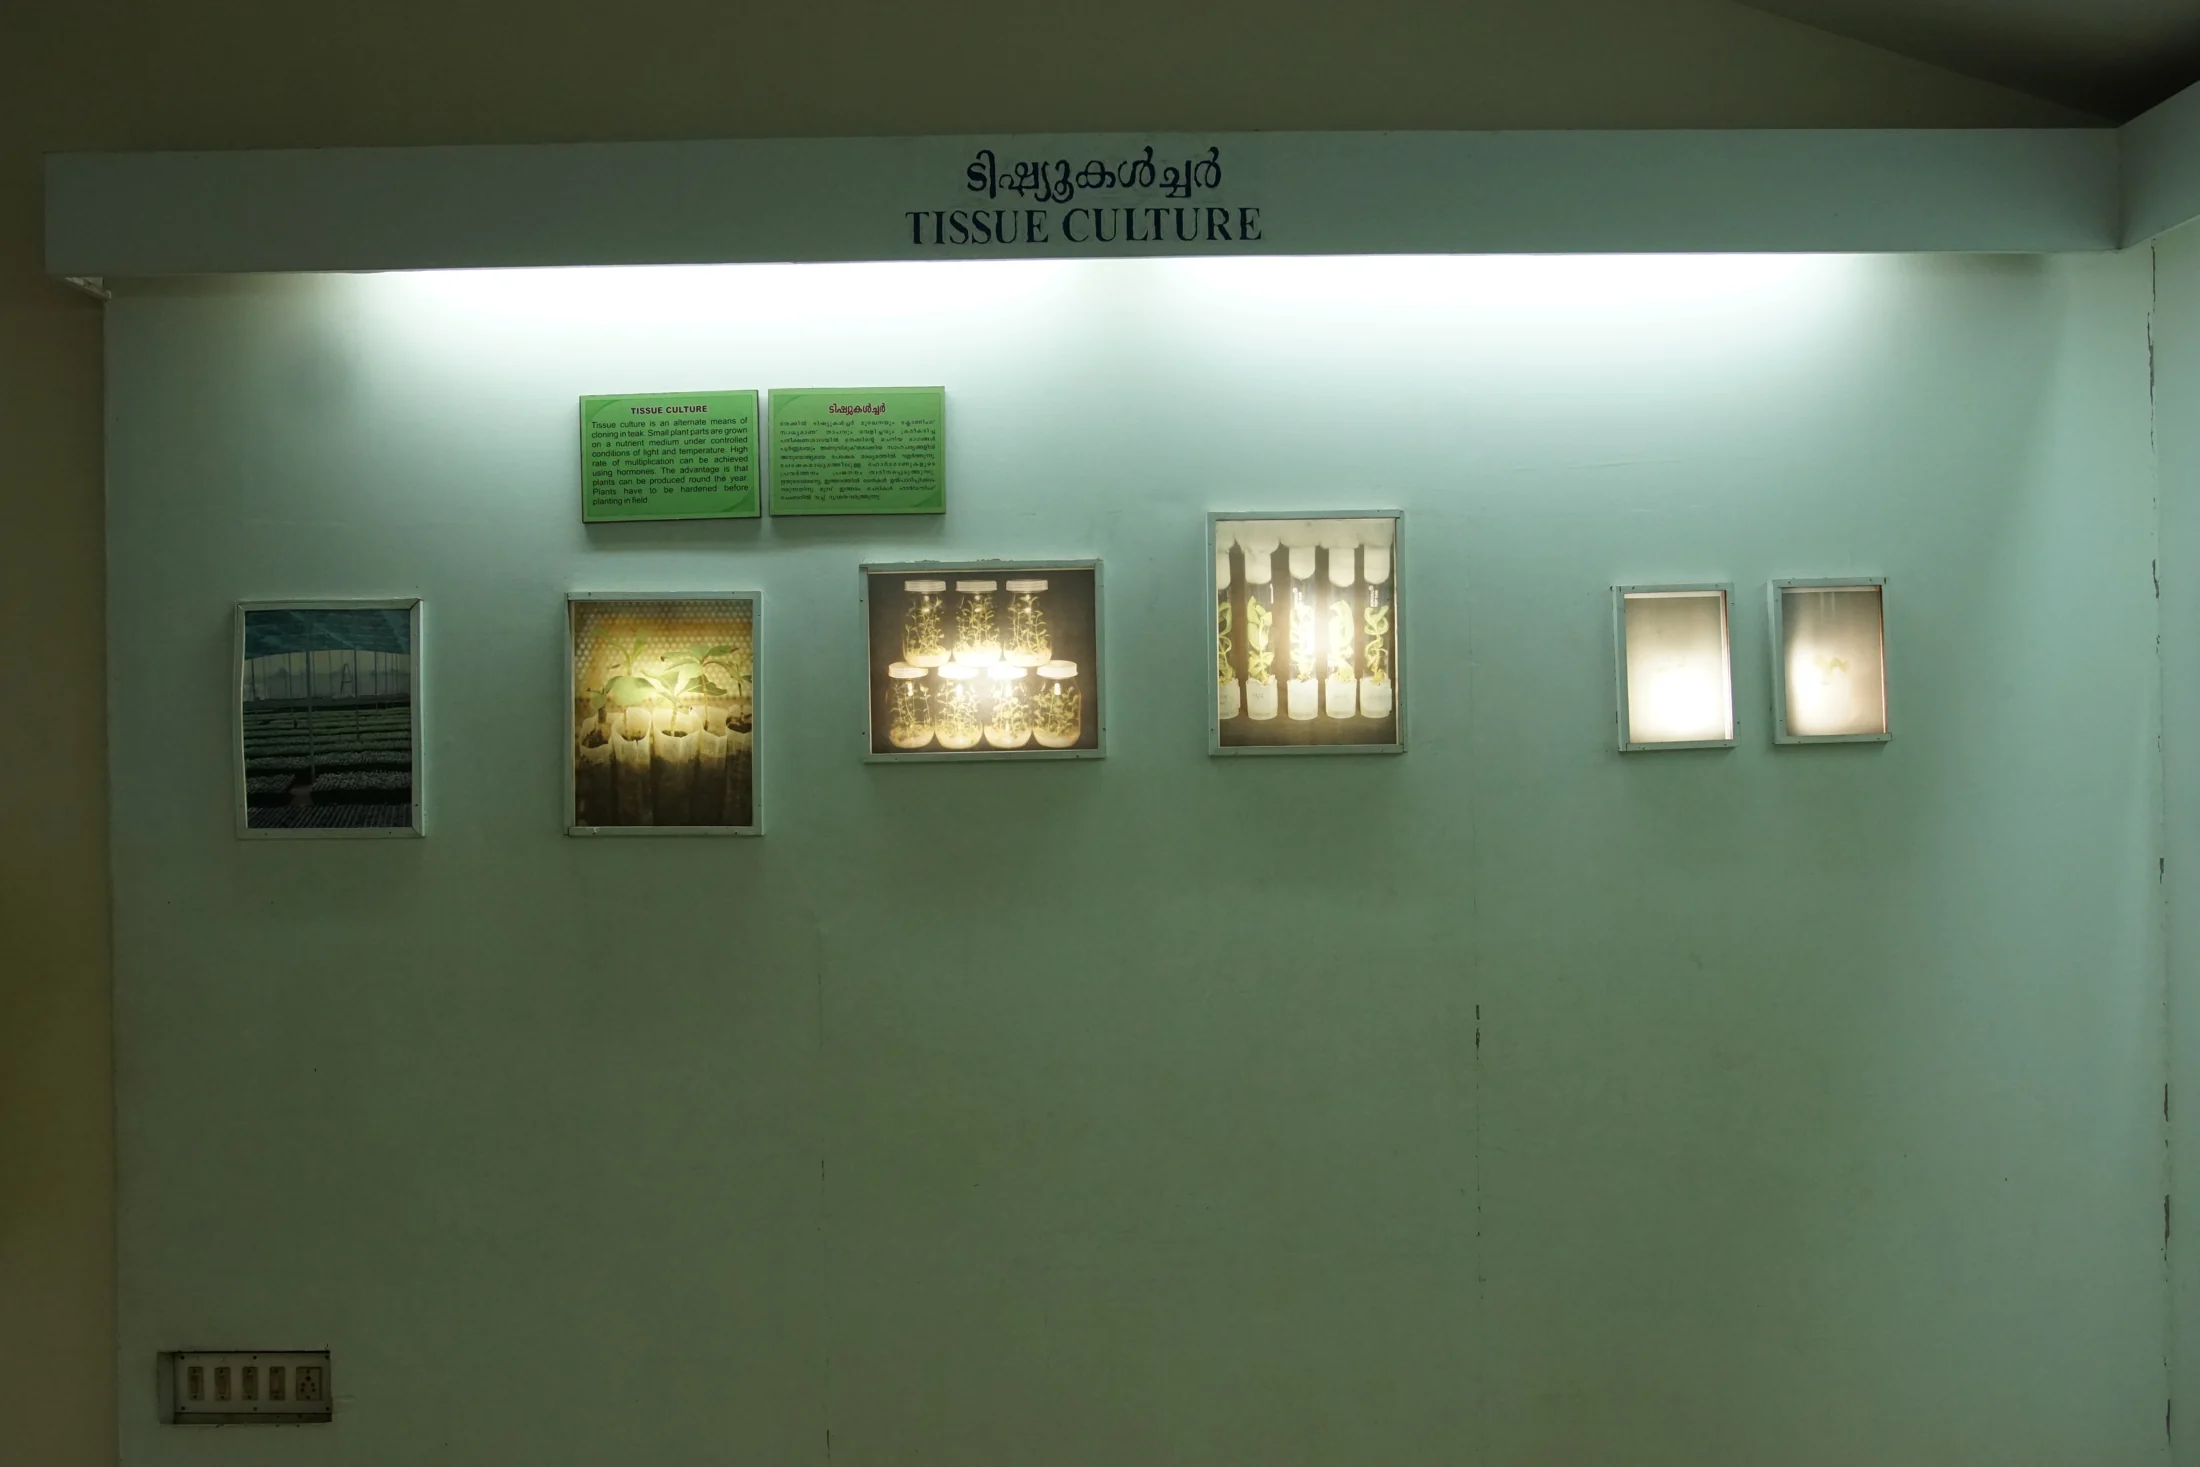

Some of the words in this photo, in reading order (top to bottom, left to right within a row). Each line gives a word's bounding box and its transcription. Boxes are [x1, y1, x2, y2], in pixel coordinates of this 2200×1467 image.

[905, 210, 1049, 245] TISSUE
[1062, 207, 1262, 242] CULTURE
[631, 407, 663, 415] TISSUE
[666, 406, 708, 414] CULTURE
[620, 420, 645, 428] culture
[592, 431, 618, 440] cloning
[670, 429, 689, 437] plant
[592, 450, 630, 458] conditions
[643, 448, 658, 457] light
[731, 446, 748, 455] High
[625, 457, 674, 467] multiplication
[714, 455, 748, 463] achieved
[593, 469, 612, 477] using
[680, 466, 719, 474] advantage
[593, 478, 615, 486] plants
[650, 476, 685, 485] produced
[689, 475, 710, 483] round
[730, 475, 748, 483] year.
[681, 485, 717, 493] hardened
[593, 497, 622, 506] planting
